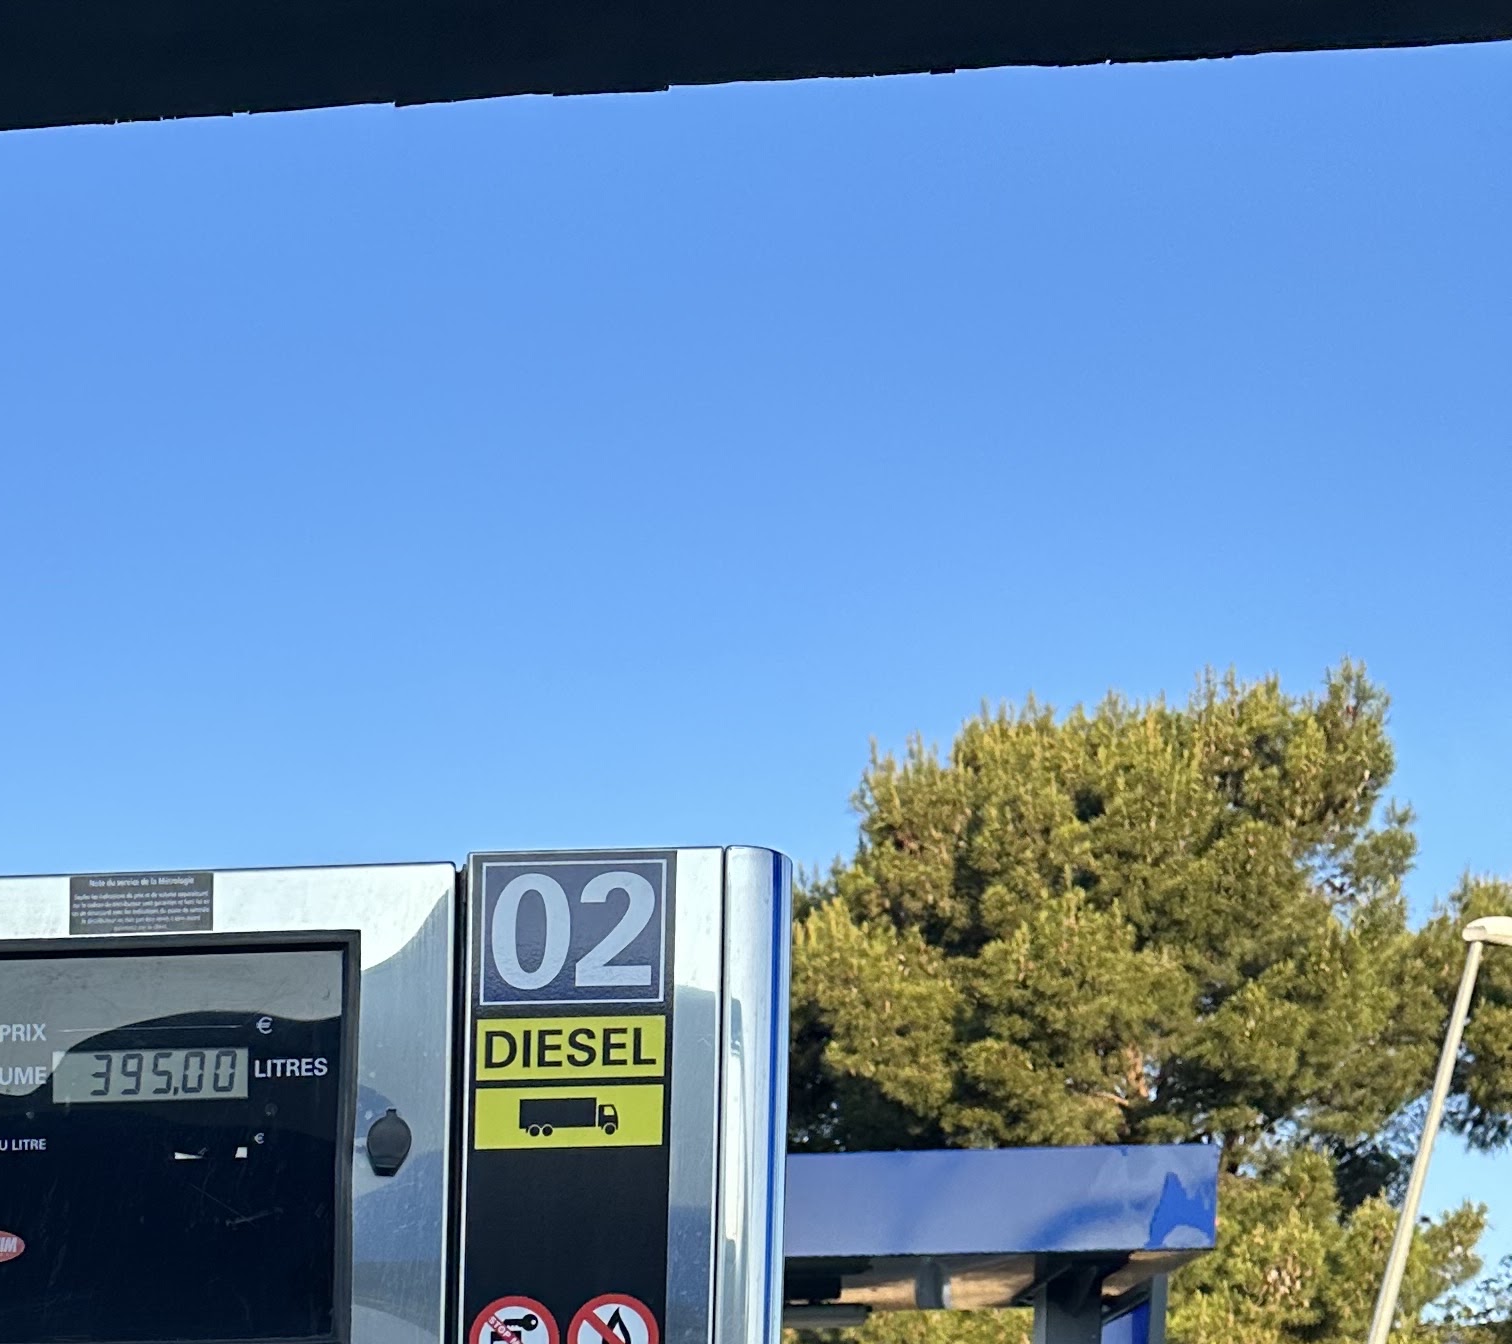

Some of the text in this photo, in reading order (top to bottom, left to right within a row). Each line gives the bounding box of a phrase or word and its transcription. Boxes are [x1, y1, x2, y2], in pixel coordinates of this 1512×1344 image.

[491, 871, 656, 990] 02
[484, 1026, 656, 1069] DIESEL
[254, 1058, 328, 1078] LITRES
[12, 1138, 47, 1152] LITRE
[488, 1315, 511, 1338] STOP
